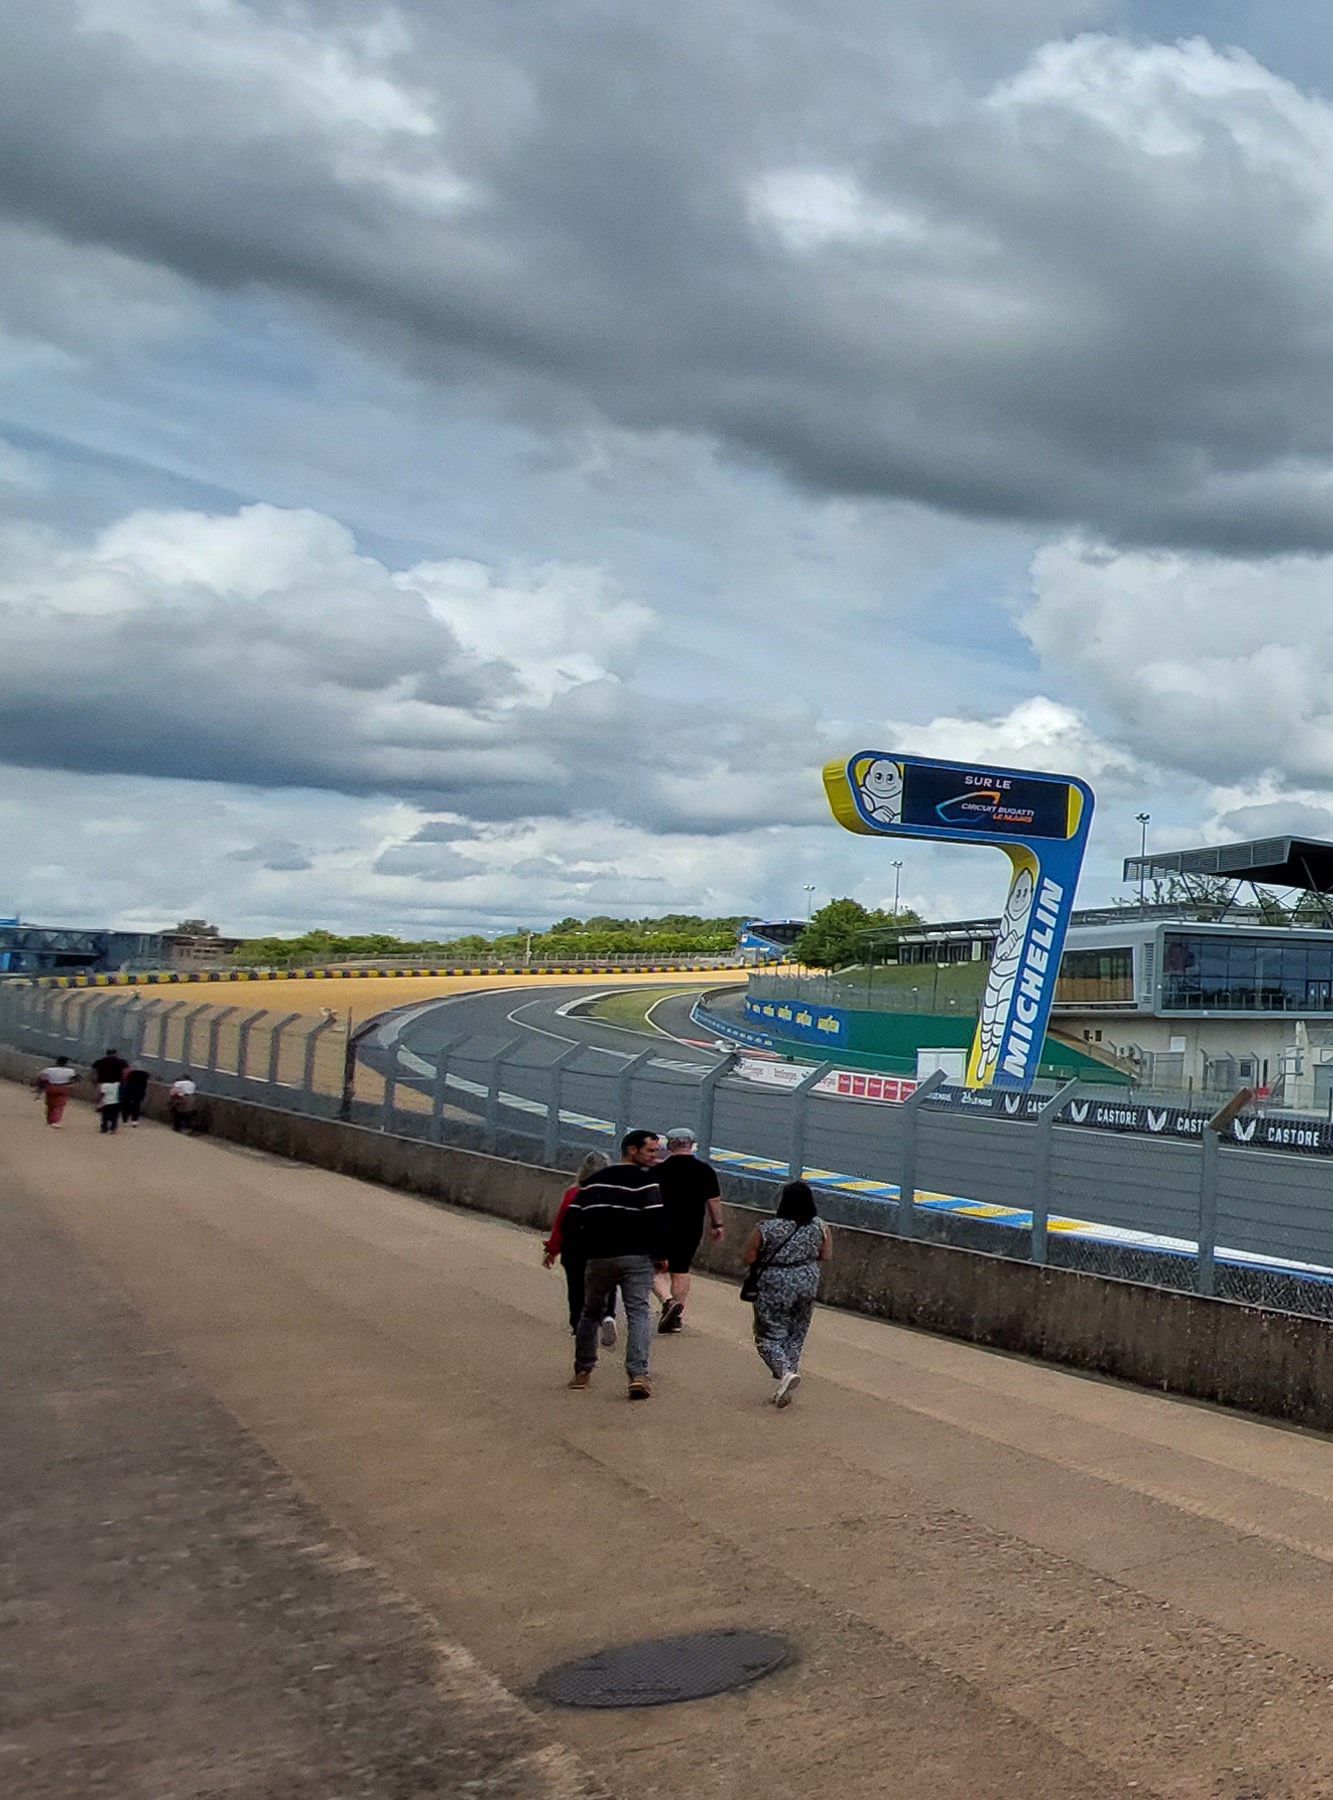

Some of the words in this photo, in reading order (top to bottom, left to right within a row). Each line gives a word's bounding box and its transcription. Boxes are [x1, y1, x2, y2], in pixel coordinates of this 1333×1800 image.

[965, 775, 992, 787] SUR
[995, 779, 1012, 789] LE
[961, 803, 997, 813] CIRCUIT
[998, 806, 1035, 816] BUGATTI
[1003, 876, 1064, 1079] MICHELIN
[1097, 1109, 1137, 1125] CASTORE
[1268, 1127, 1319, 1147] CASTORE
